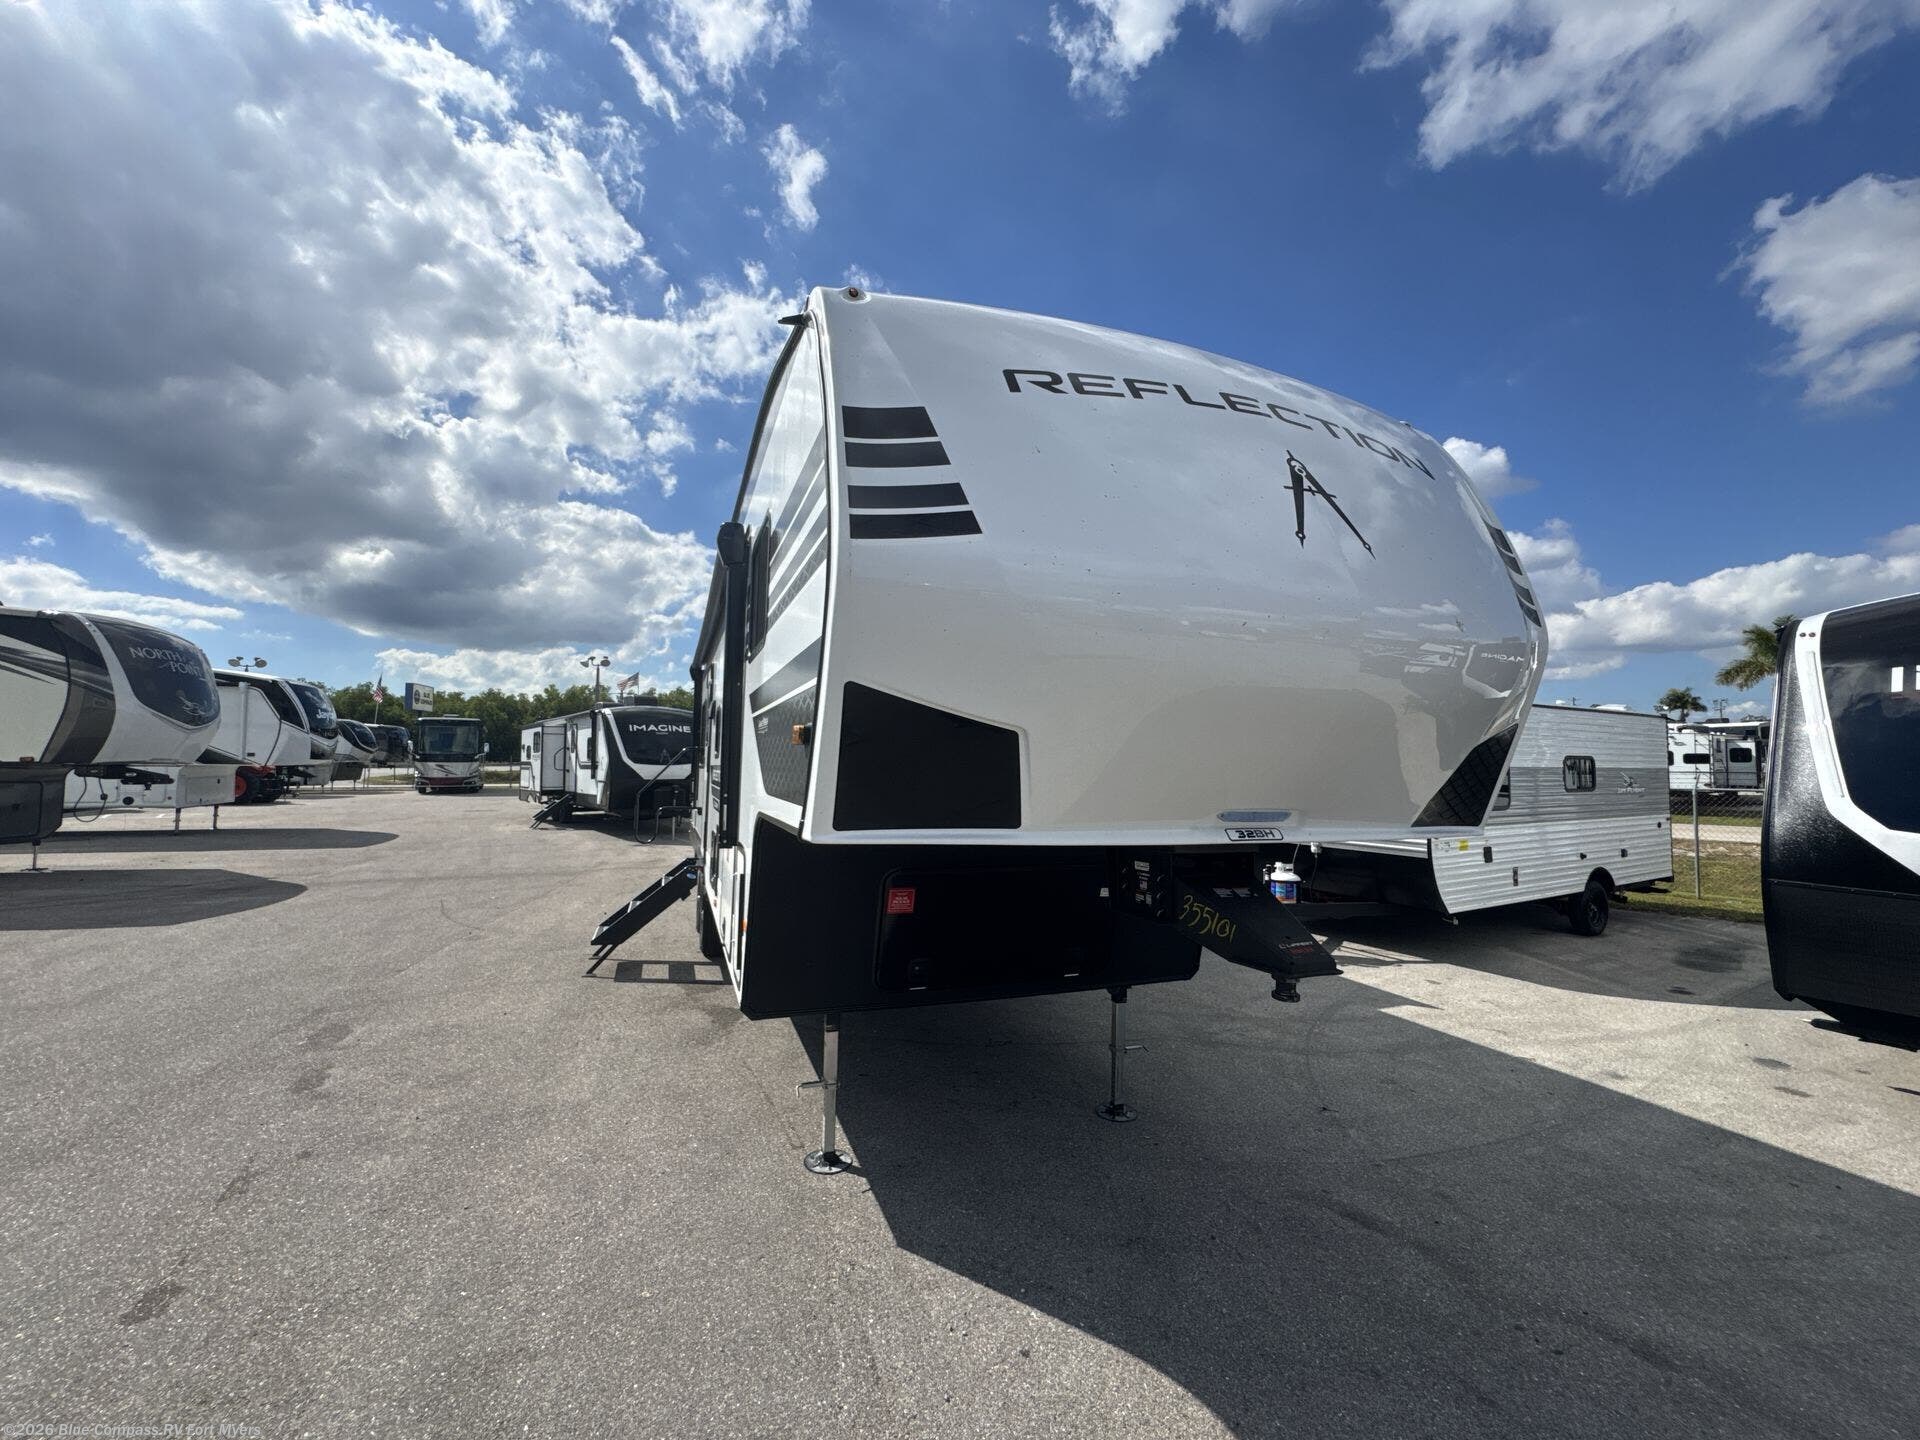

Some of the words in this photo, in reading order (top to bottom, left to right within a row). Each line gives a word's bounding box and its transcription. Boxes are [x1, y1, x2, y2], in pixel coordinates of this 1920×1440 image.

[1001, 368, 1436, 482] REFLECTION
[128, 646, 183, 662] NORTH
[168, 661, 202, 677] POINT
[628, 724, 692, 733] IMAGINE
[1235, 829, 1276, 839] 32BH
[1178, 894, 1237, 944] 355101
